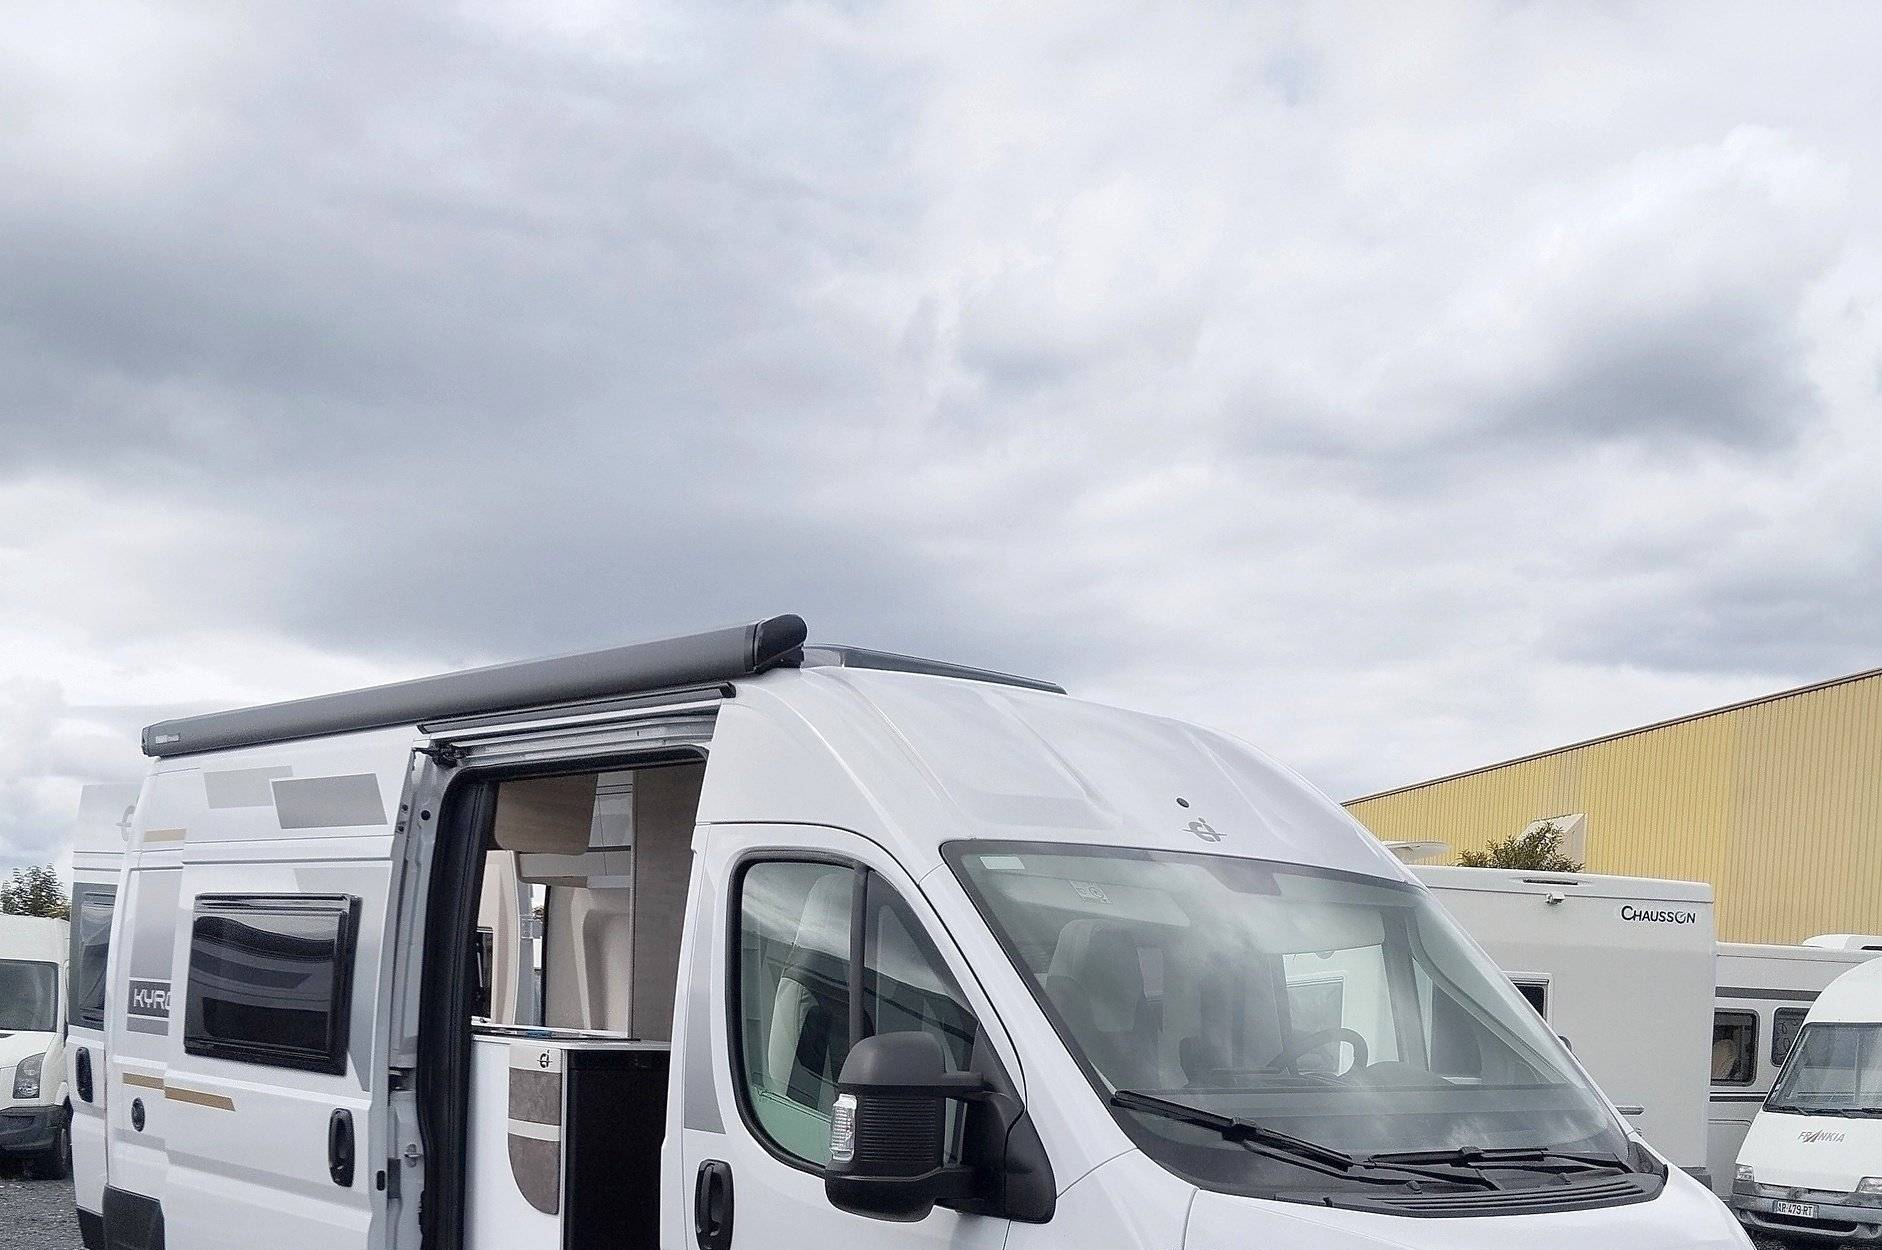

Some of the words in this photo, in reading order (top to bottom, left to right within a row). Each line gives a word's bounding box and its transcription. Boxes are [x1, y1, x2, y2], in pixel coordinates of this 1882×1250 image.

[1621, 905, 1696, 924] CHAUSSON
[133, 988, 171, 1010] KYRO
[1797, 1129, 1846, 1143] FRANKIA
